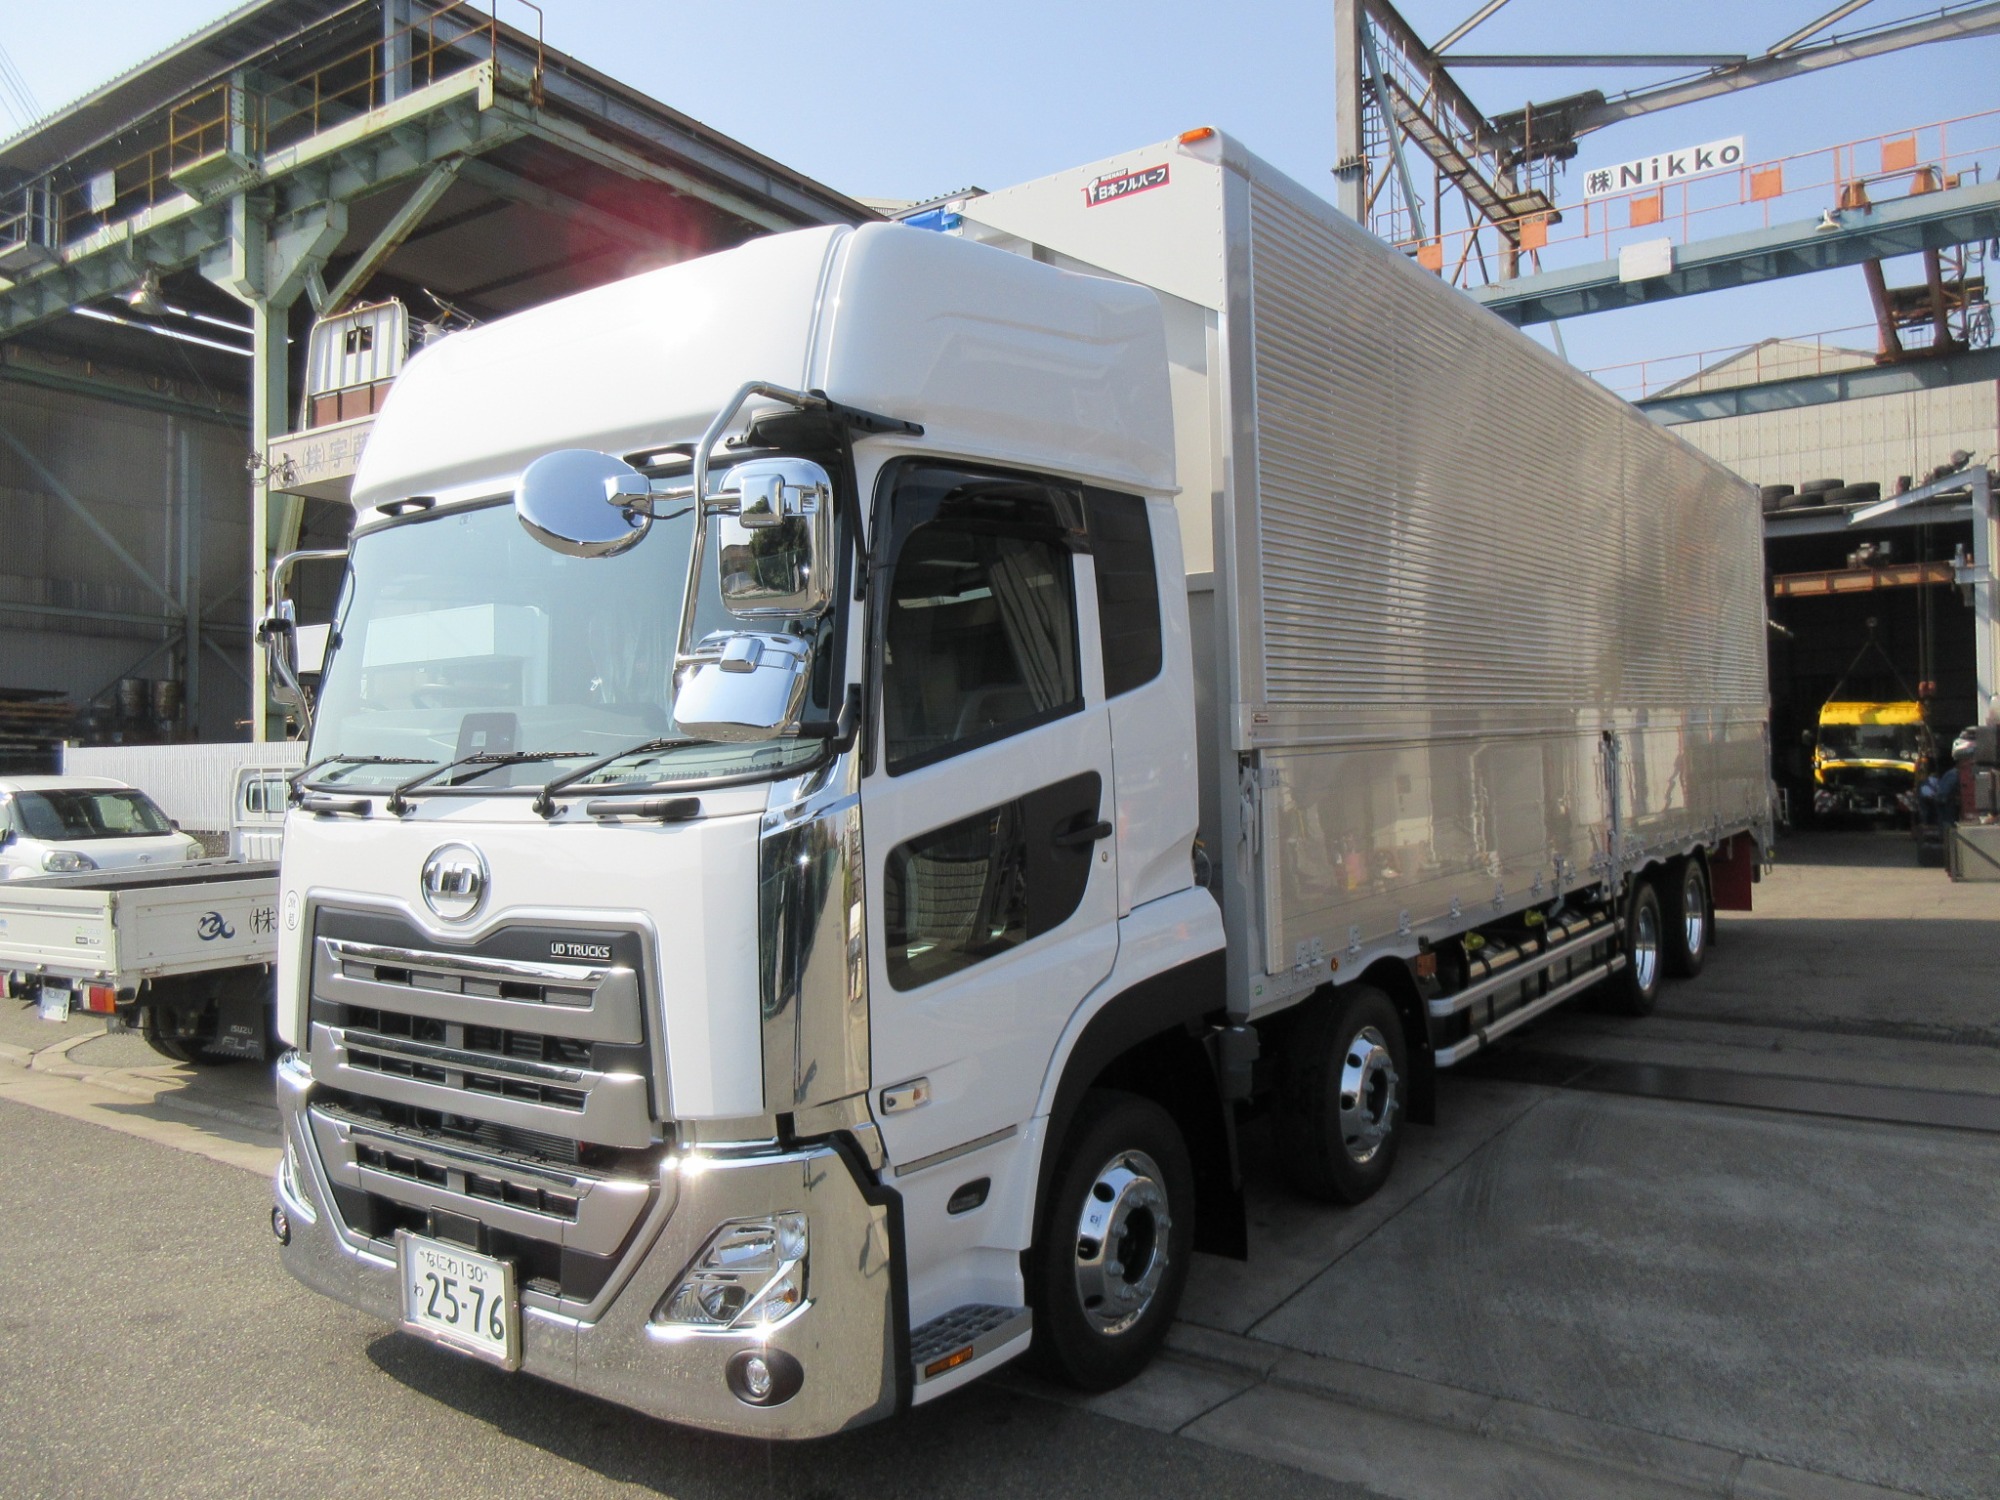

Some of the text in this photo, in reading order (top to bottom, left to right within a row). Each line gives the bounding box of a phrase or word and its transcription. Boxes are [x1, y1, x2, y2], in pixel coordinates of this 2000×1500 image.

[1099, 168, 1166, 200] 日本フルハーフ
[551, 942, 611, 958] UD TRUCKS
[413, 1271, 505, 1341] わ 25-76
